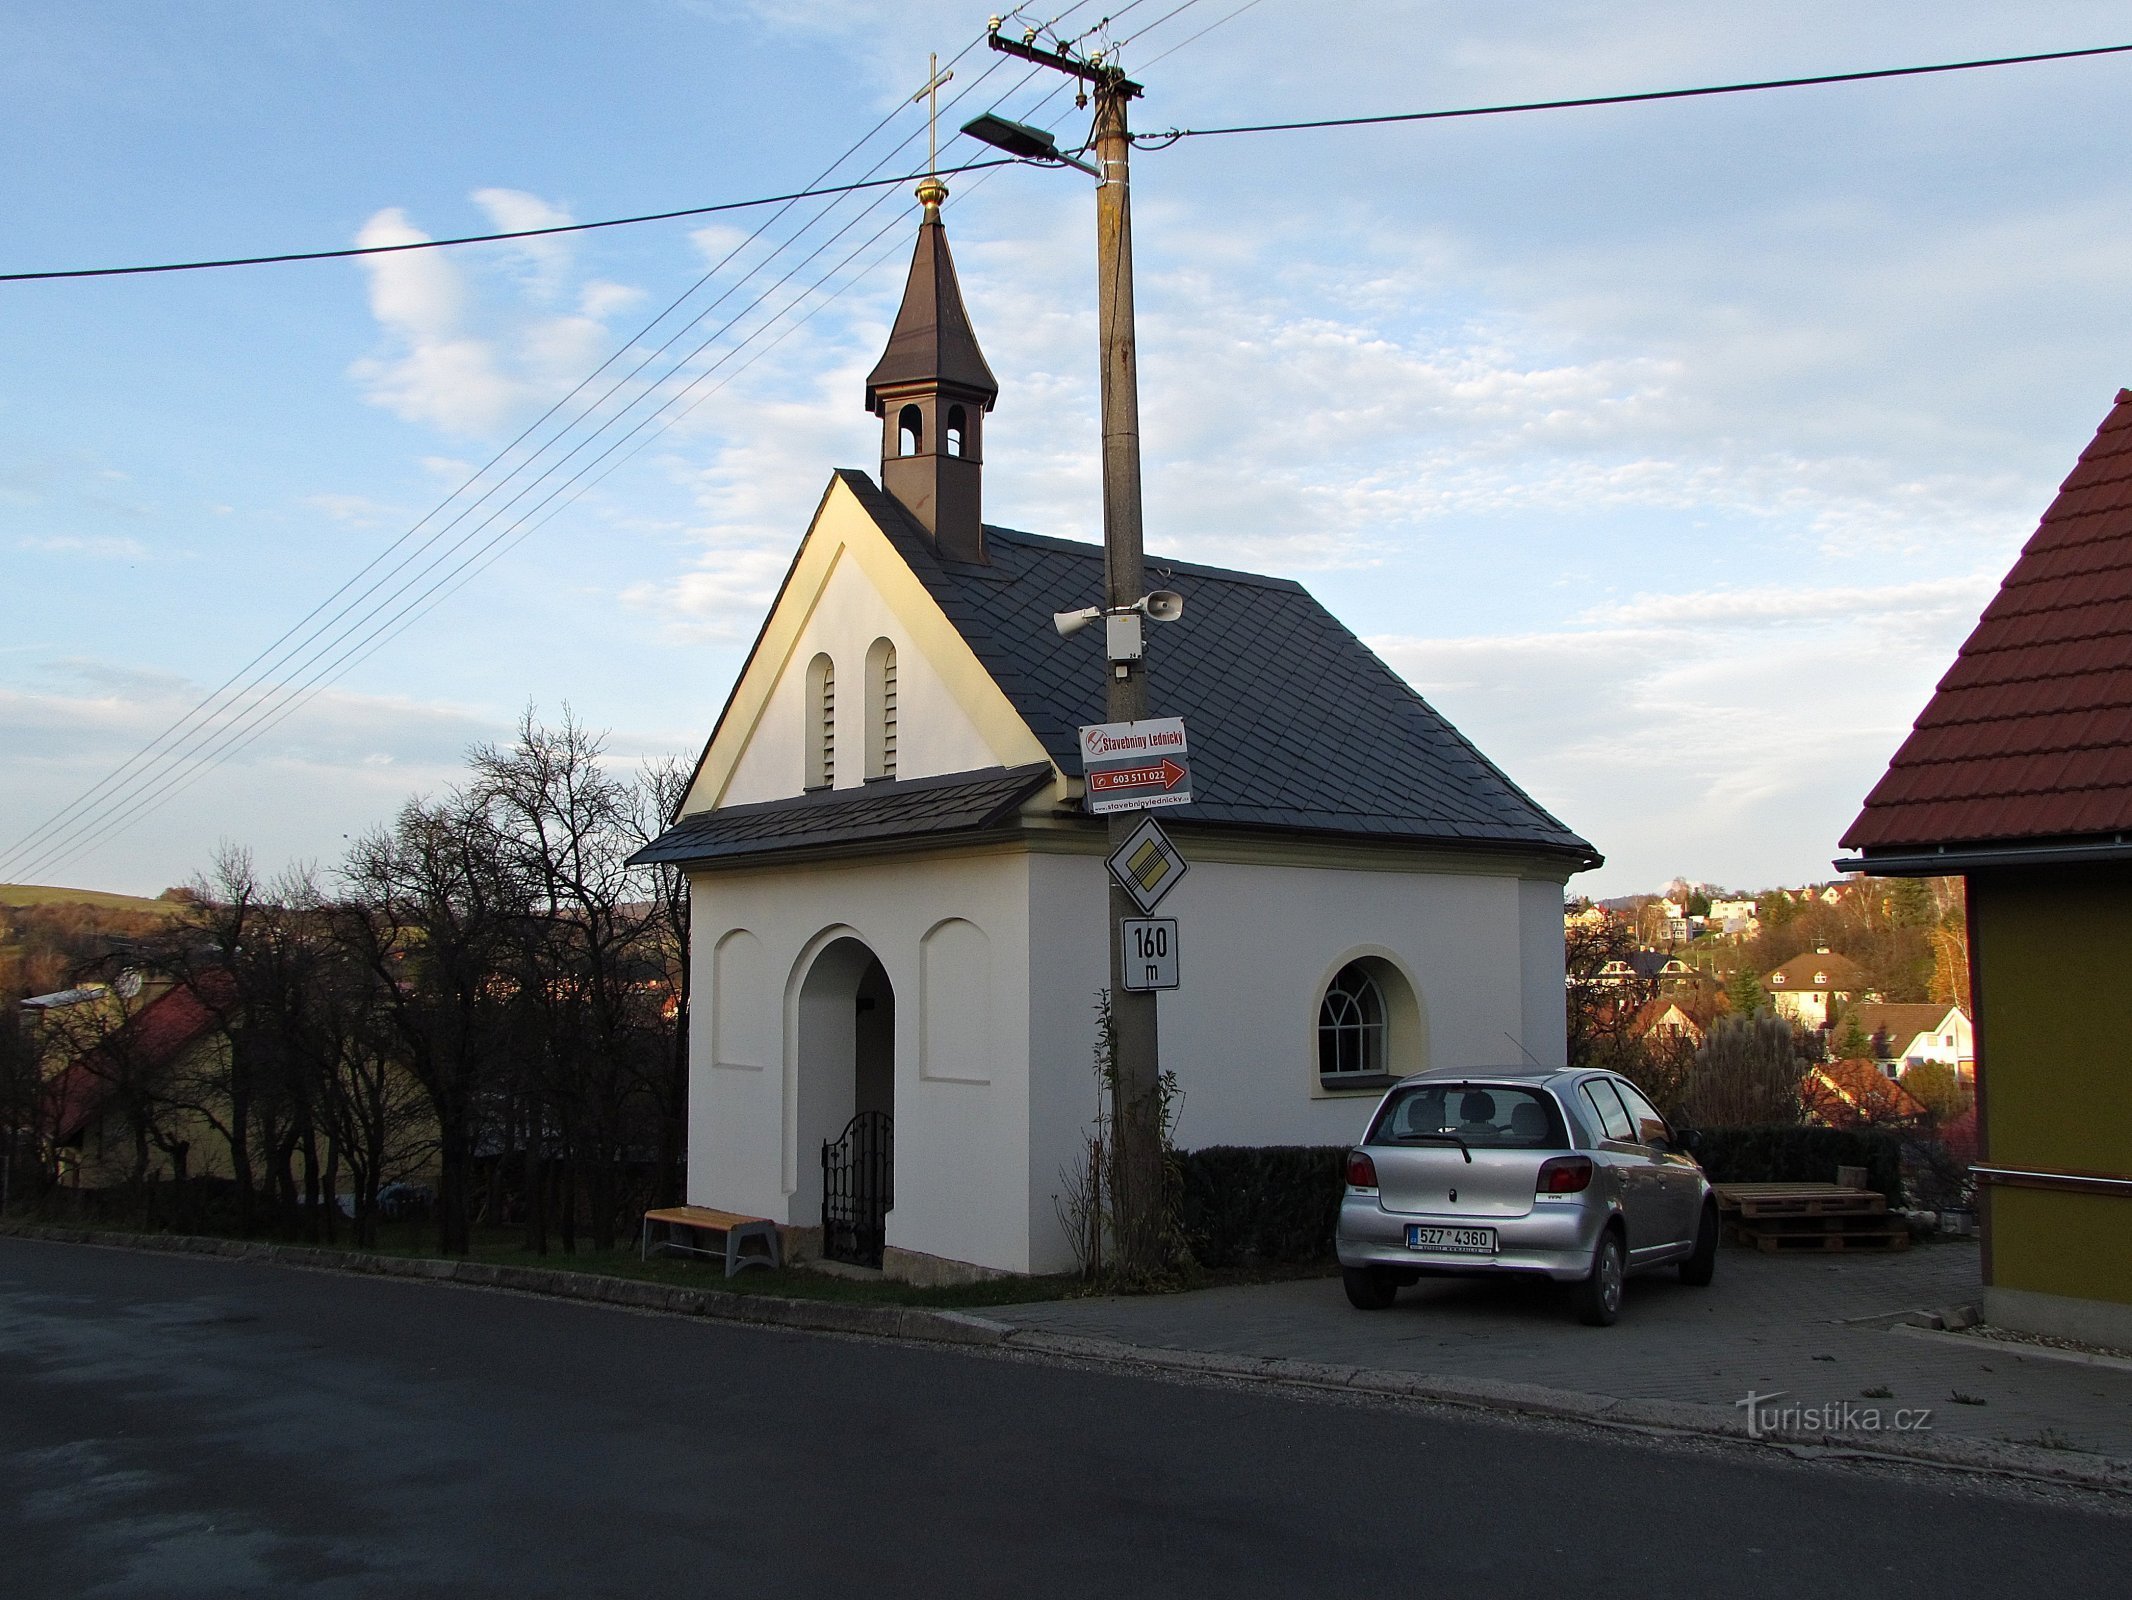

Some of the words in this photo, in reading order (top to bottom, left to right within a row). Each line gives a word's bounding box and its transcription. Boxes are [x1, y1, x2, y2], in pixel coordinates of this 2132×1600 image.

[1102, 735, 1147, 751] Stavebniny
[1113, 774, 1129, 784] 603
[1132, 772, 1147, 782] 511
[1149, 770, 1165, 780] 022
[1134, 927, 1167, 958] 160
[1145, 964, 1158, 980] m
[1420, 1229, 1445, 1244] 5Z7
[1454, 1230, 1487, 1246] 4360
